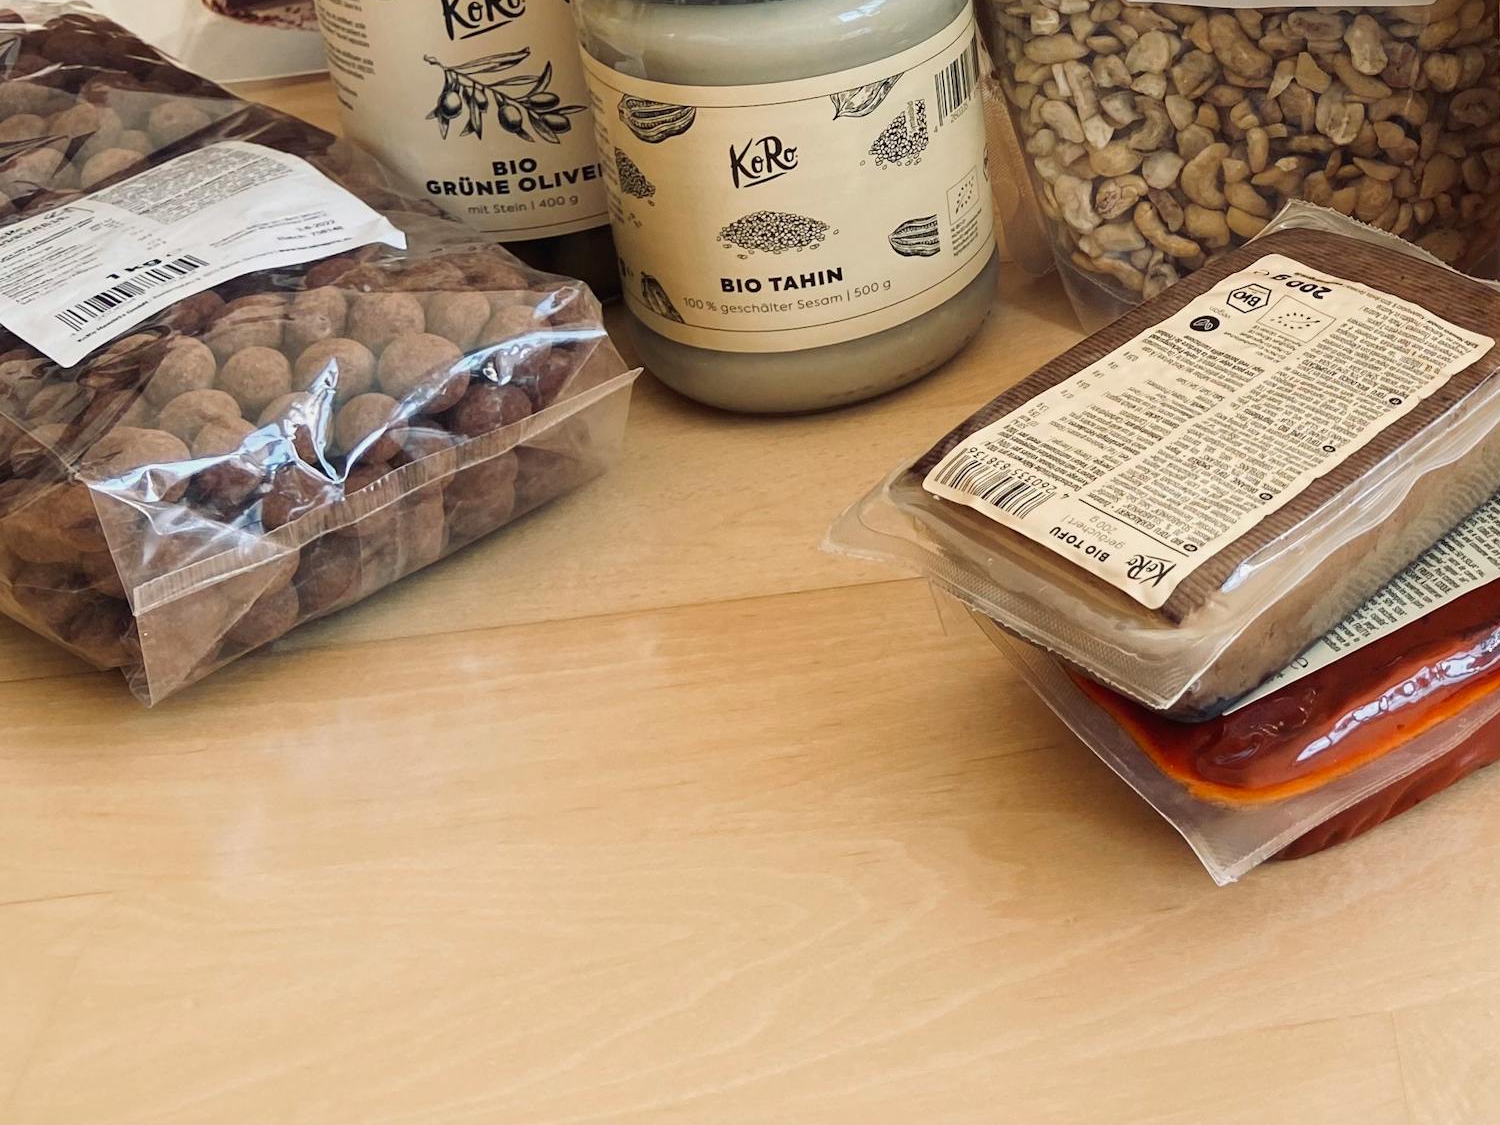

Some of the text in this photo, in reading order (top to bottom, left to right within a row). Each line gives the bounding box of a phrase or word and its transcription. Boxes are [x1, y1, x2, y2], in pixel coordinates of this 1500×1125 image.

[492, 158, 538, 176] BIO
[730, 135, 799, 189] KoRo
[426, 177, 510, 196] GRÜNE
[467, 203, 490, 216] mit
[494, 201, 527, 214] Stein
[538, 195, 564, 209] 400
[569, 195, 579, 205] g
[720, 266, 844, 293] BIO TAHIN
[683, 296, 704, 311] 100
[705, 301, 717, 311] %
[721, 299, 793, 315] geschälter
[798, 294, 843, 310] Sesam
[854, 281, 880, 300] 500
[880, 278, 892, 292] g
[1233, 291, 1262, 307] BIO
[968, 447, 1013, 472] 838136
[1011, 469, 1058, 493] 260335
[1049, 526, 1110, 563] BIO TOFU
[1125, 554, 1177, 588] KoRo
